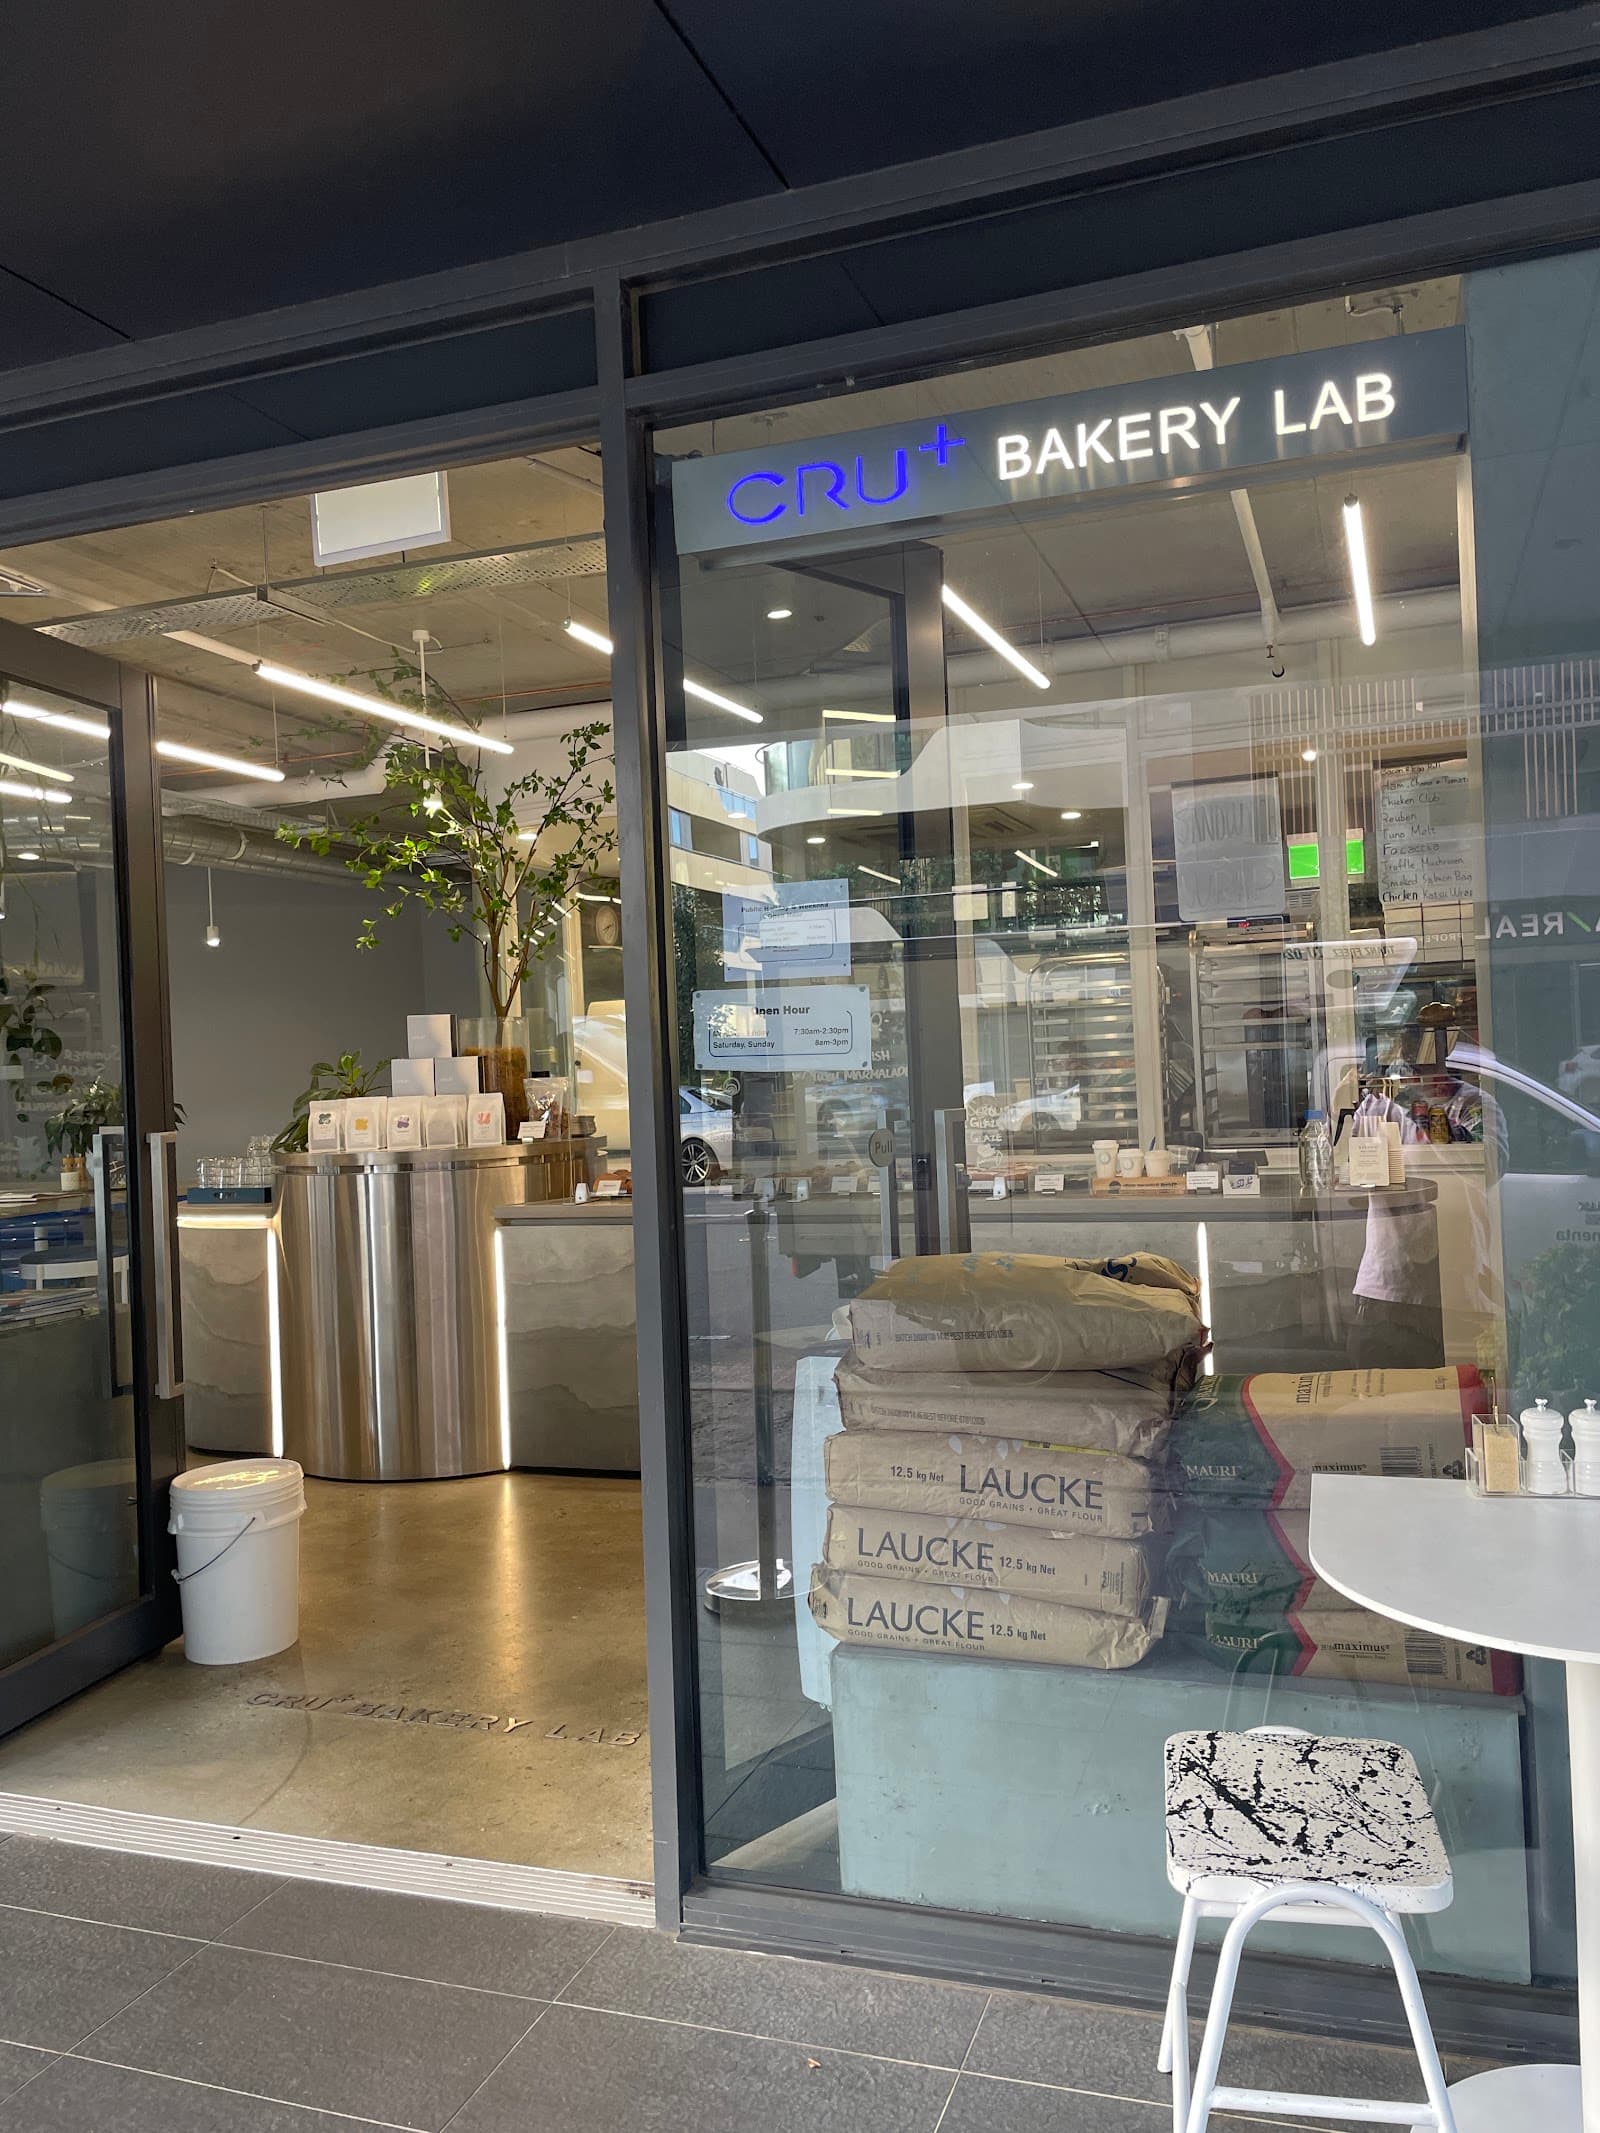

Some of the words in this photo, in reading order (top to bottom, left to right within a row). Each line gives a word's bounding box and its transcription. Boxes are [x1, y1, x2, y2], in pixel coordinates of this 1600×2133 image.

[997, 396, 1241, 481] BAKERY
[1274, 372, 1396, 436] LAB
[1418, 791, 1441, 803] Club
[1382, 811, 1416, 823] Reuben
[1383, 828, 1407, 840] Tuna
[1382, 873, 1418, 889] Smoked
[1382, 889, 1418, 903] Chicken
[783, 1005, 810, 1015] Hour
[794, 1027, 849, 1037] 7:30am-2:30pm
[748, 1040, 775, 1050] Sunday
[814, 1038, 849, 1048] 8am-3pm
[875, 1140, 893, 1154] Pull
[1186, 1464, 1238, 1478] MAURI
[890, 1465, 914, 1480] 12.5
[916, 1471, 927, 1484] kg
[929, 1471, 944, 1483] Net
[960, 1464, 1103, 1511] LAUCKE
[959, 1496, 986, 1508] GOOD
[990, 1500, 1025, 1513] GRAINS
[1037, 1507, 1069, 1518] GREAT
[1071, 1511, 1103, 1522] FLOUR
[857, 1528, 995, 1573] LAUCKE
[857, 1559, 884, 1569] GOOD
[887, 1562, 921, 1574] GRAINS
[932, 1568, 962, 1580] GREAT
[965, 1573, 994, 1584] FLOUR
[999, 1556, 1023, 1571] 12.5
[1026, 1561, 1037, 1575] kg
[1039, 1563, 1056, 1576] Net
[1207, 1572, 1258, 1585] MAURI
[847, 1597, 985, 1641] LAUCKE
[989, 1623, 1014, 1638] 12.5
[1016, 1628, 1027, 1641] kg
[1029, 1629, 1047, 1641] Net
[847, 1628, 874, 1639] GOOD
[877, 1632, 911, 1643] GRAINS
[923, 1637, 951, 1648] GREAT
[955, 1641, 986, 1652] FLOUR
[1333, 1640, 1386, 1652] maximus
[347, 1703, 534, 1733] BAKERY
[545, 1723, 641, 1747] LAB
